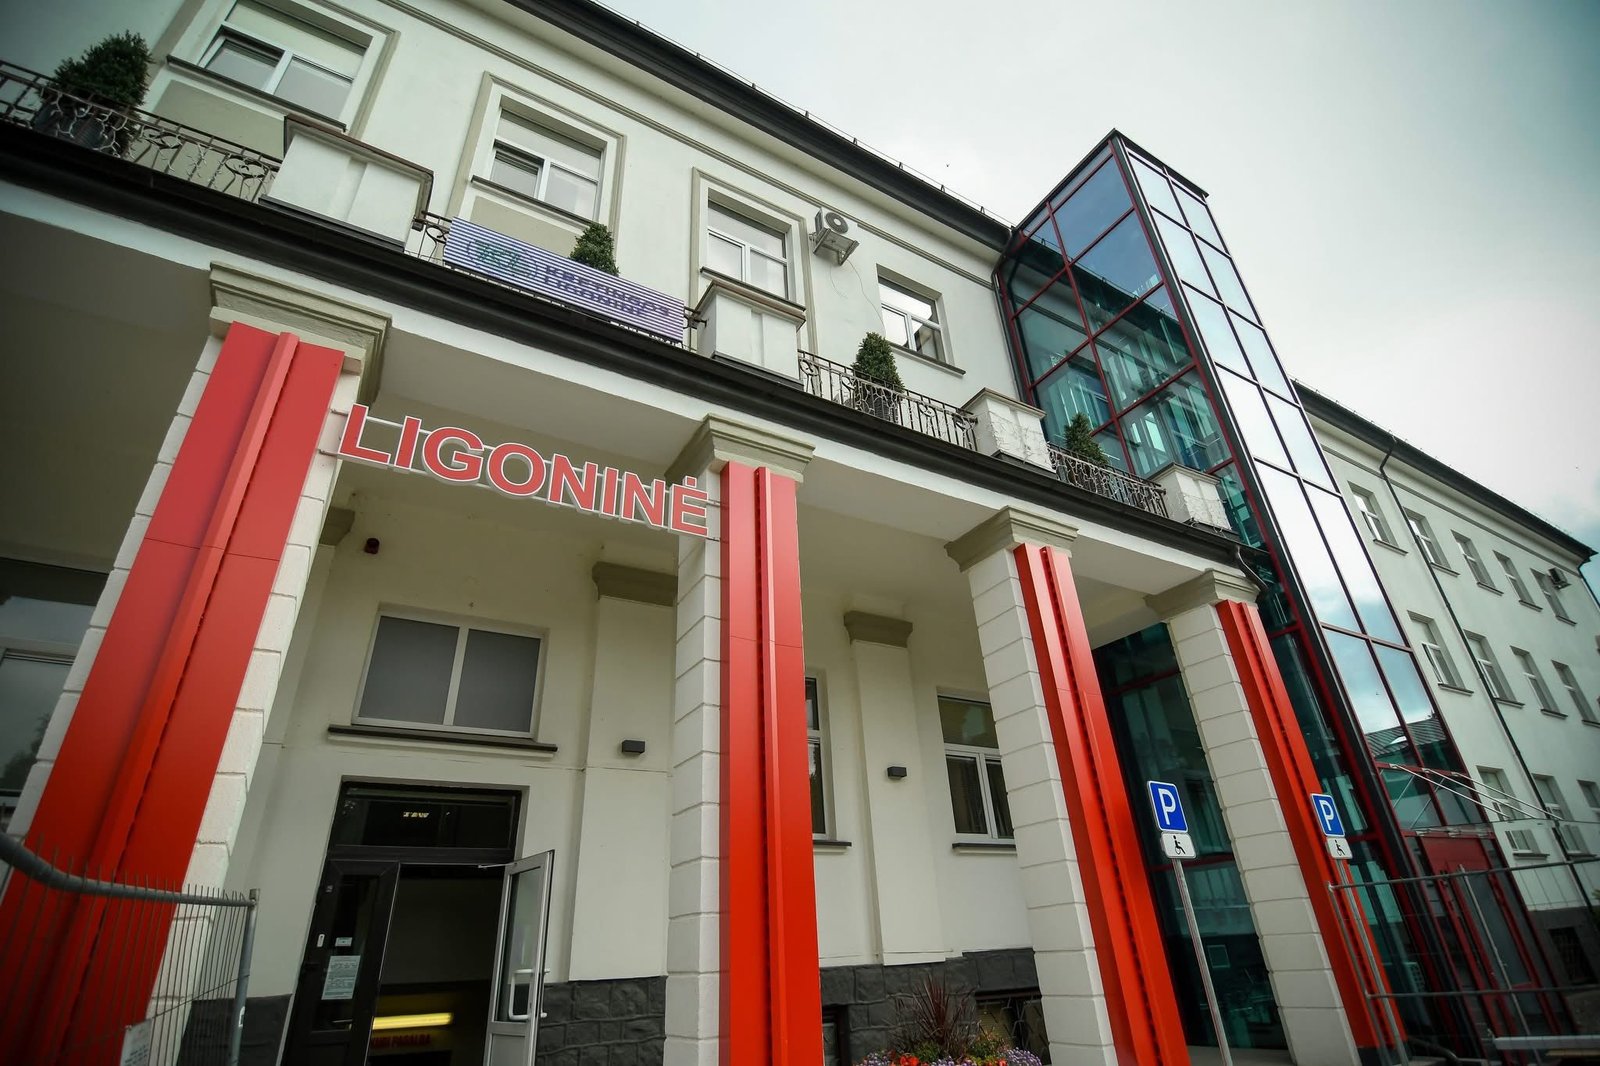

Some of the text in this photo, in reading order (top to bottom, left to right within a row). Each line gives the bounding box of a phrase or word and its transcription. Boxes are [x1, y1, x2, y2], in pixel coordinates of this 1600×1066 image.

[338, 403, 709, 538] LIGONINĖ
[1158, 788, 1176, 825] P
[1319, 799, 1335, 831] P
